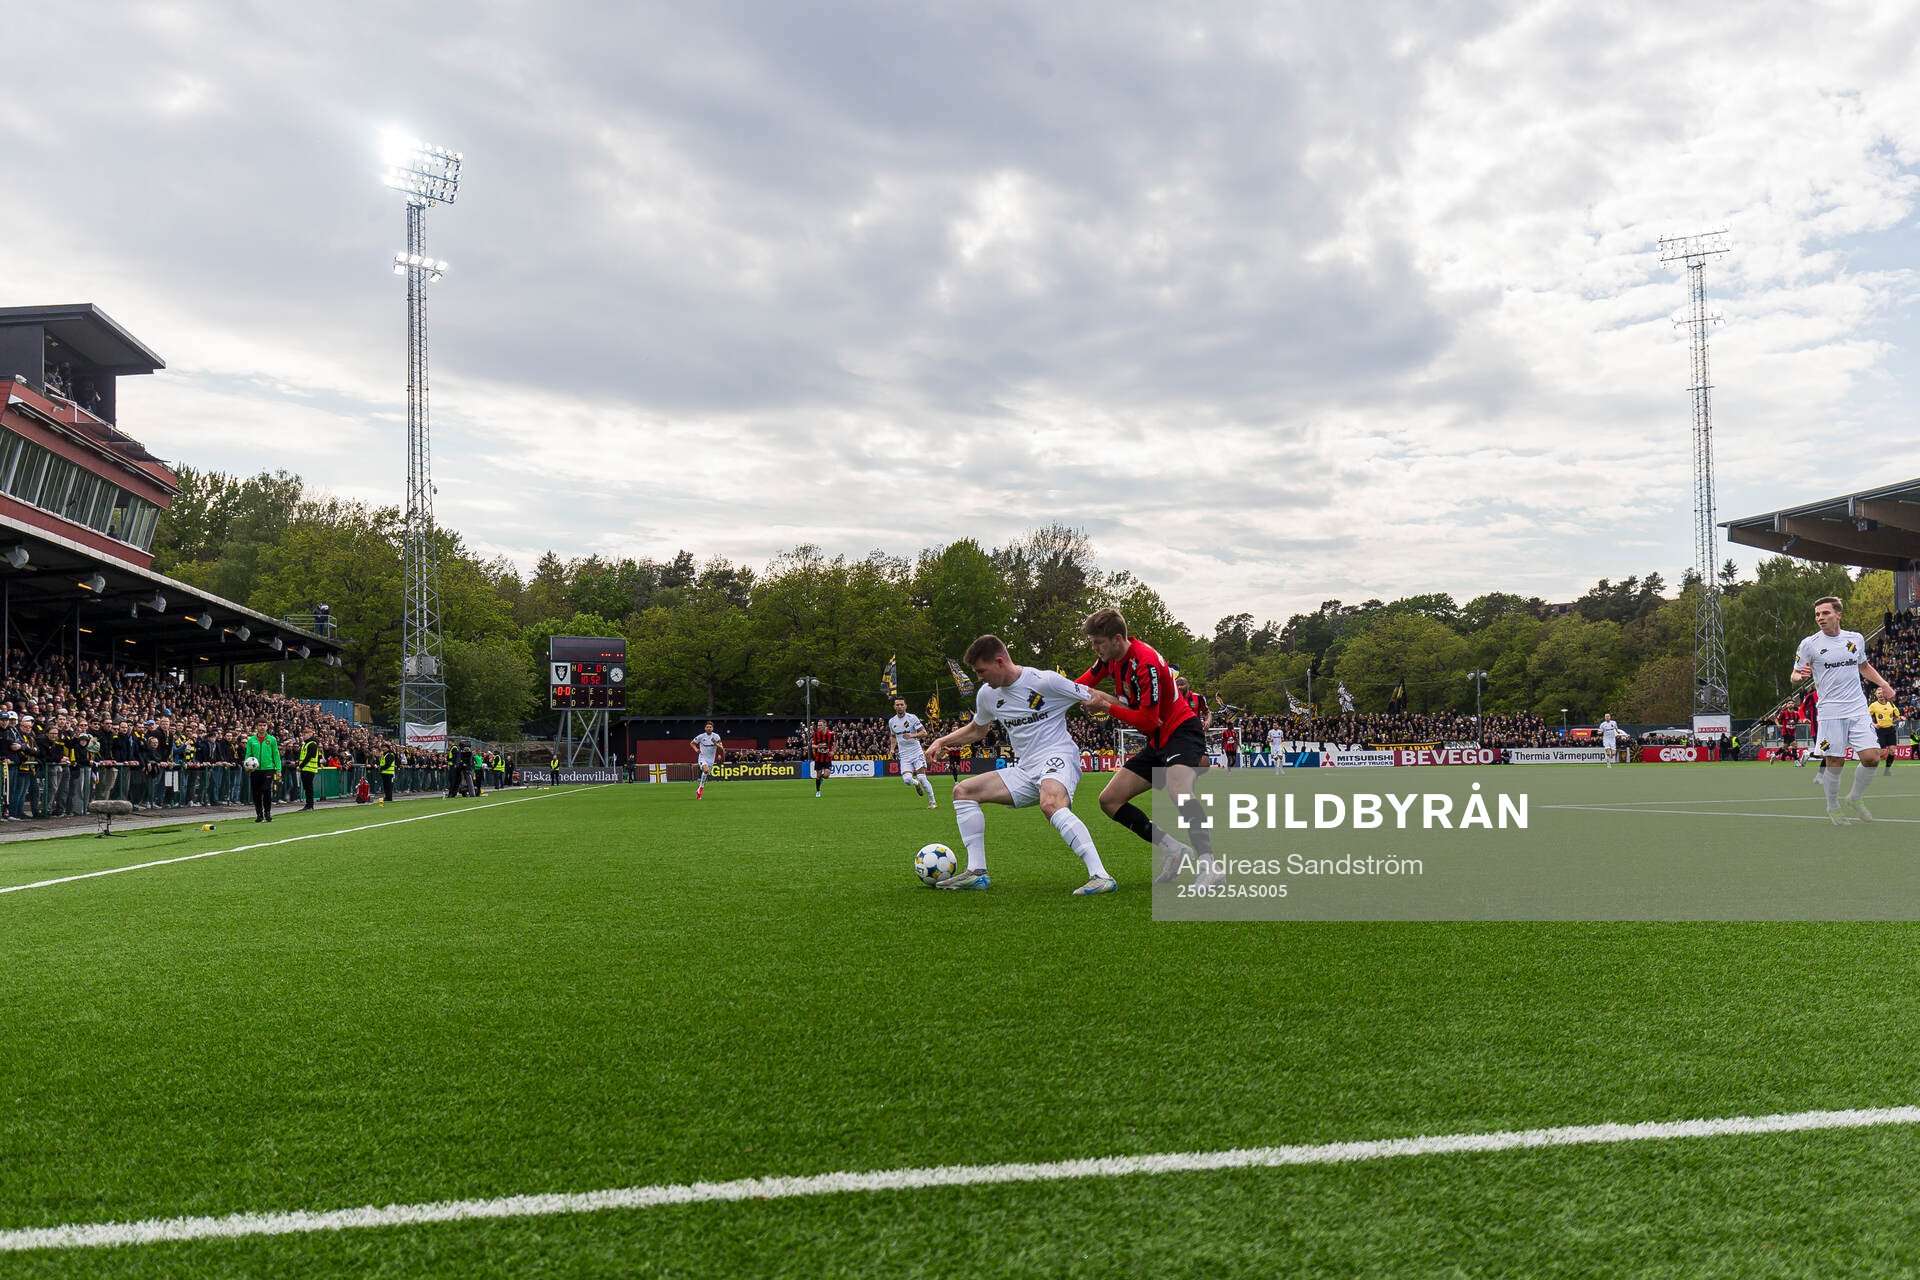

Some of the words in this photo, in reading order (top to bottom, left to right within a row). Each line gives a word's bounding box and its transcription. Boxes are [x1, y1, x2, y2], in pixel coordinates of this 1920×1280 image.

[1003, 711, 1049, 729] truecaller
[1401, 749, 1494, 766] BEVEGO
[1515, 751, 1550, 760] Thermia
[710, 763, 795, 779] GipsProffsen
